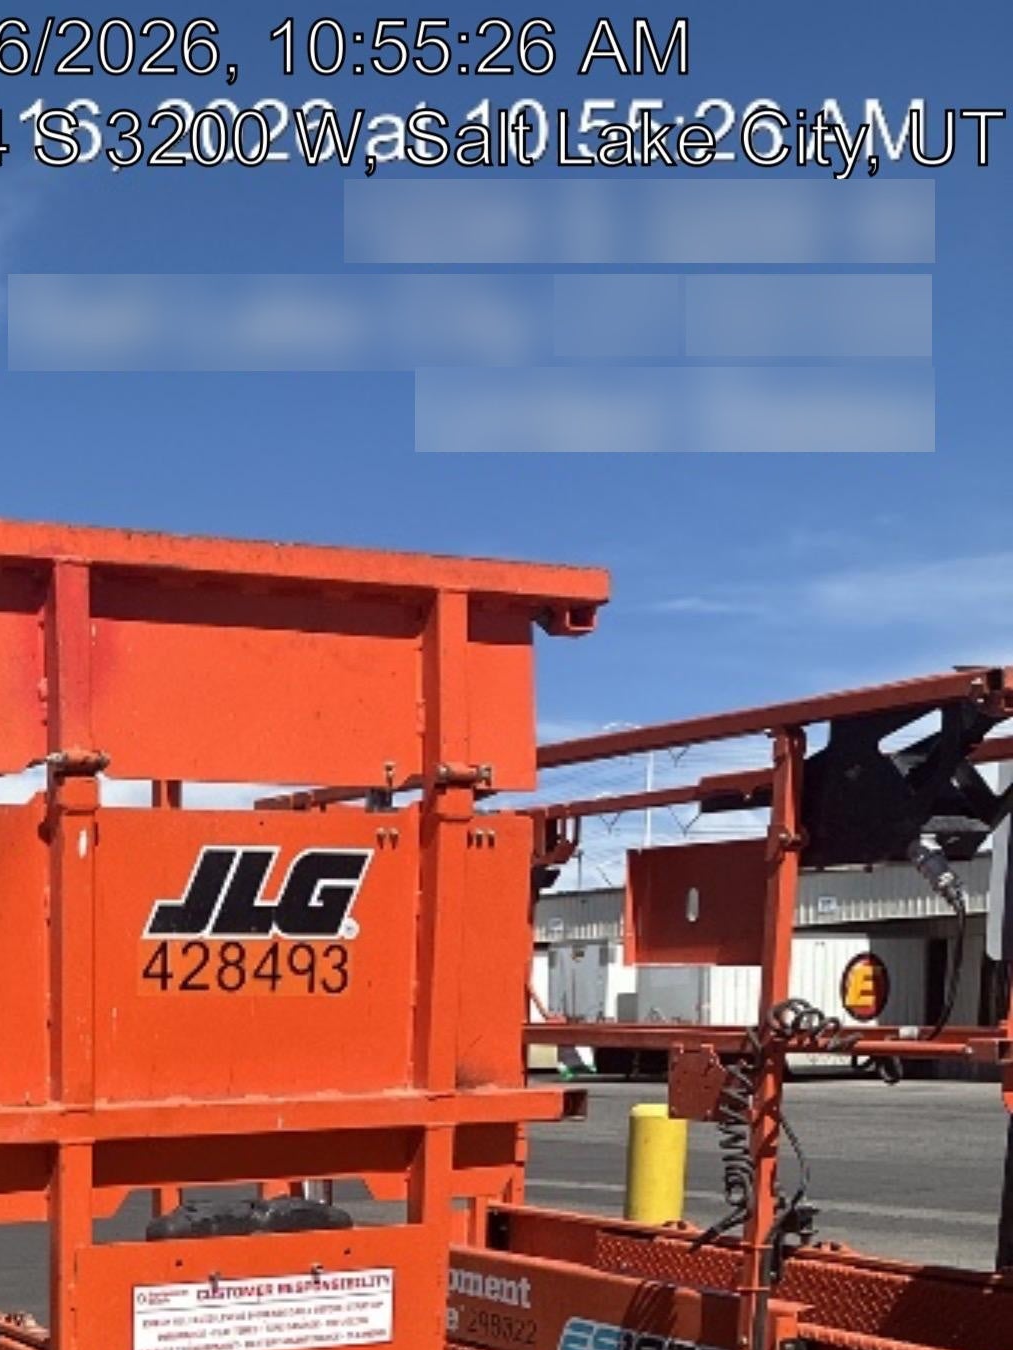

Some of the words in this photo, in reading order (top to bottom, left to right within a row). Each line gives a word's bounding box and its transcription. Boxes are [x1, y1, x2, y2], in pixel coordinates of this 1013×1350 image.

[141, 845, 374, 940] JLG
[142, 940, 349, 994] 428493
[845, 961, 878, 1007] E
